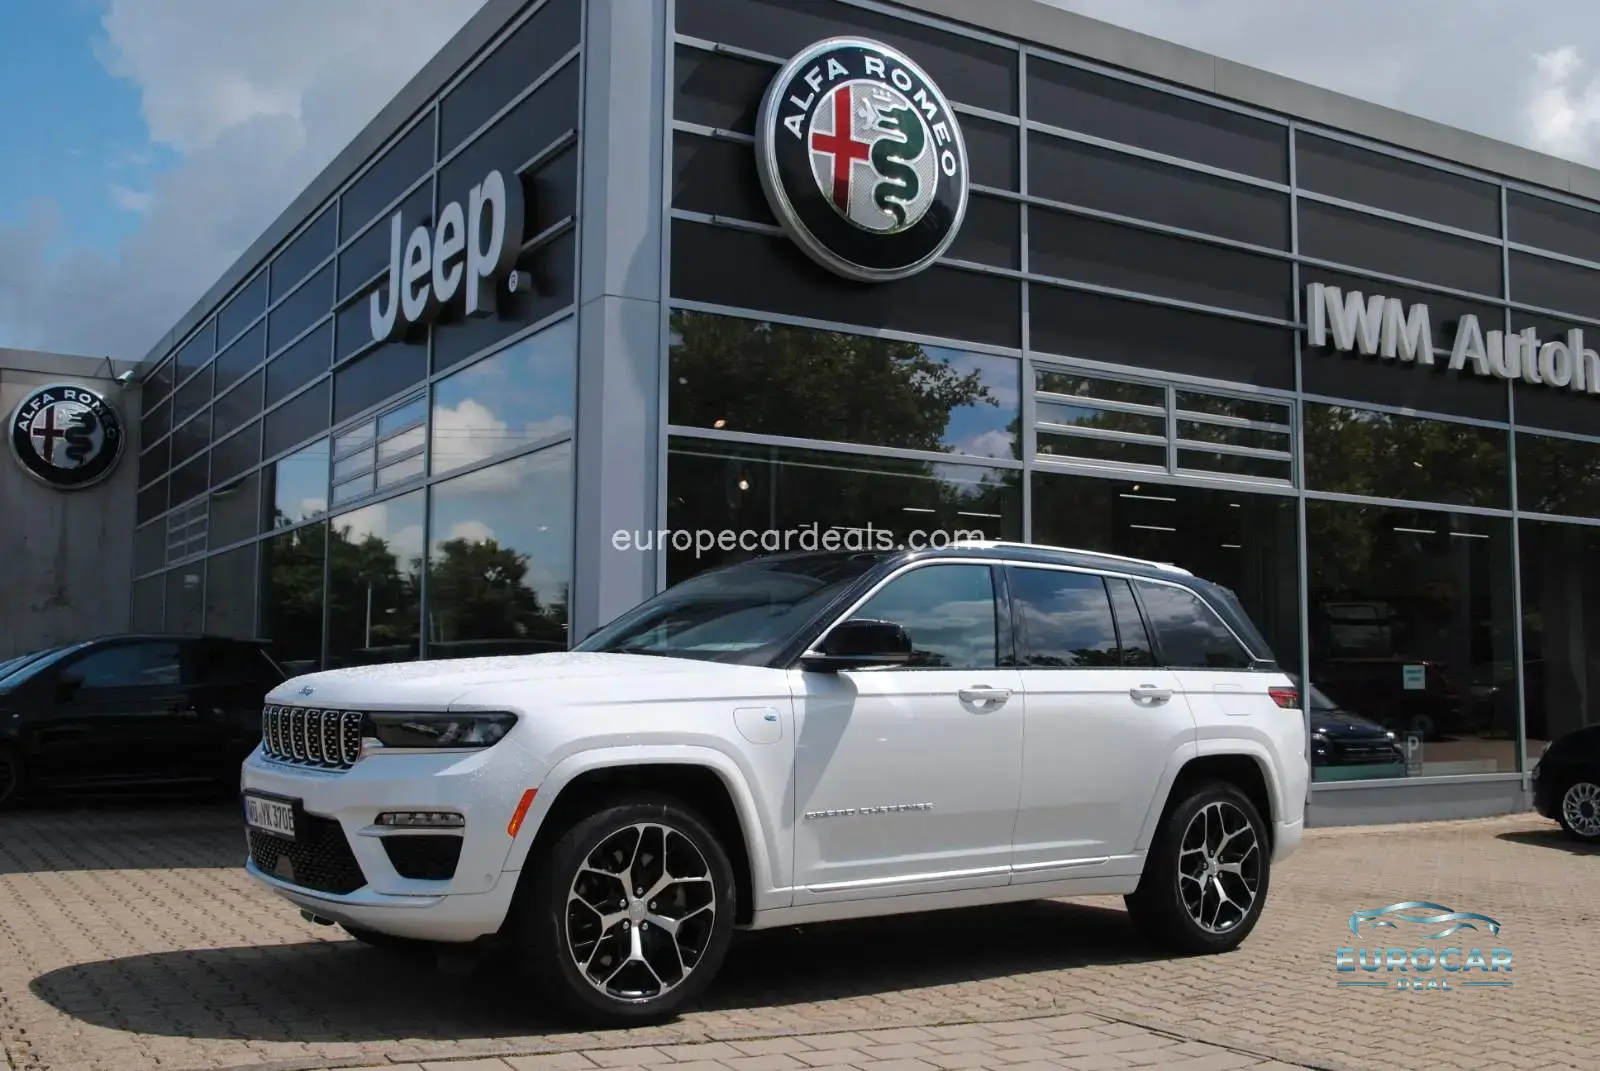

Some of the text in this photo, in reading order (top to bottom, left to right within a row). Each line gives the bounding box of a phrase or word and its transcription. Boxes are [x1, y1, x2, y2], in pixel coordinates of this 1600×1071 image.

[783, 55, 957, 177] ALFA ROMEO
[370, 169, 507, 342] Jeep
[1306, 282, 1600, 394] IWM Autoh
[18, 392, 56, 432] ALFA
